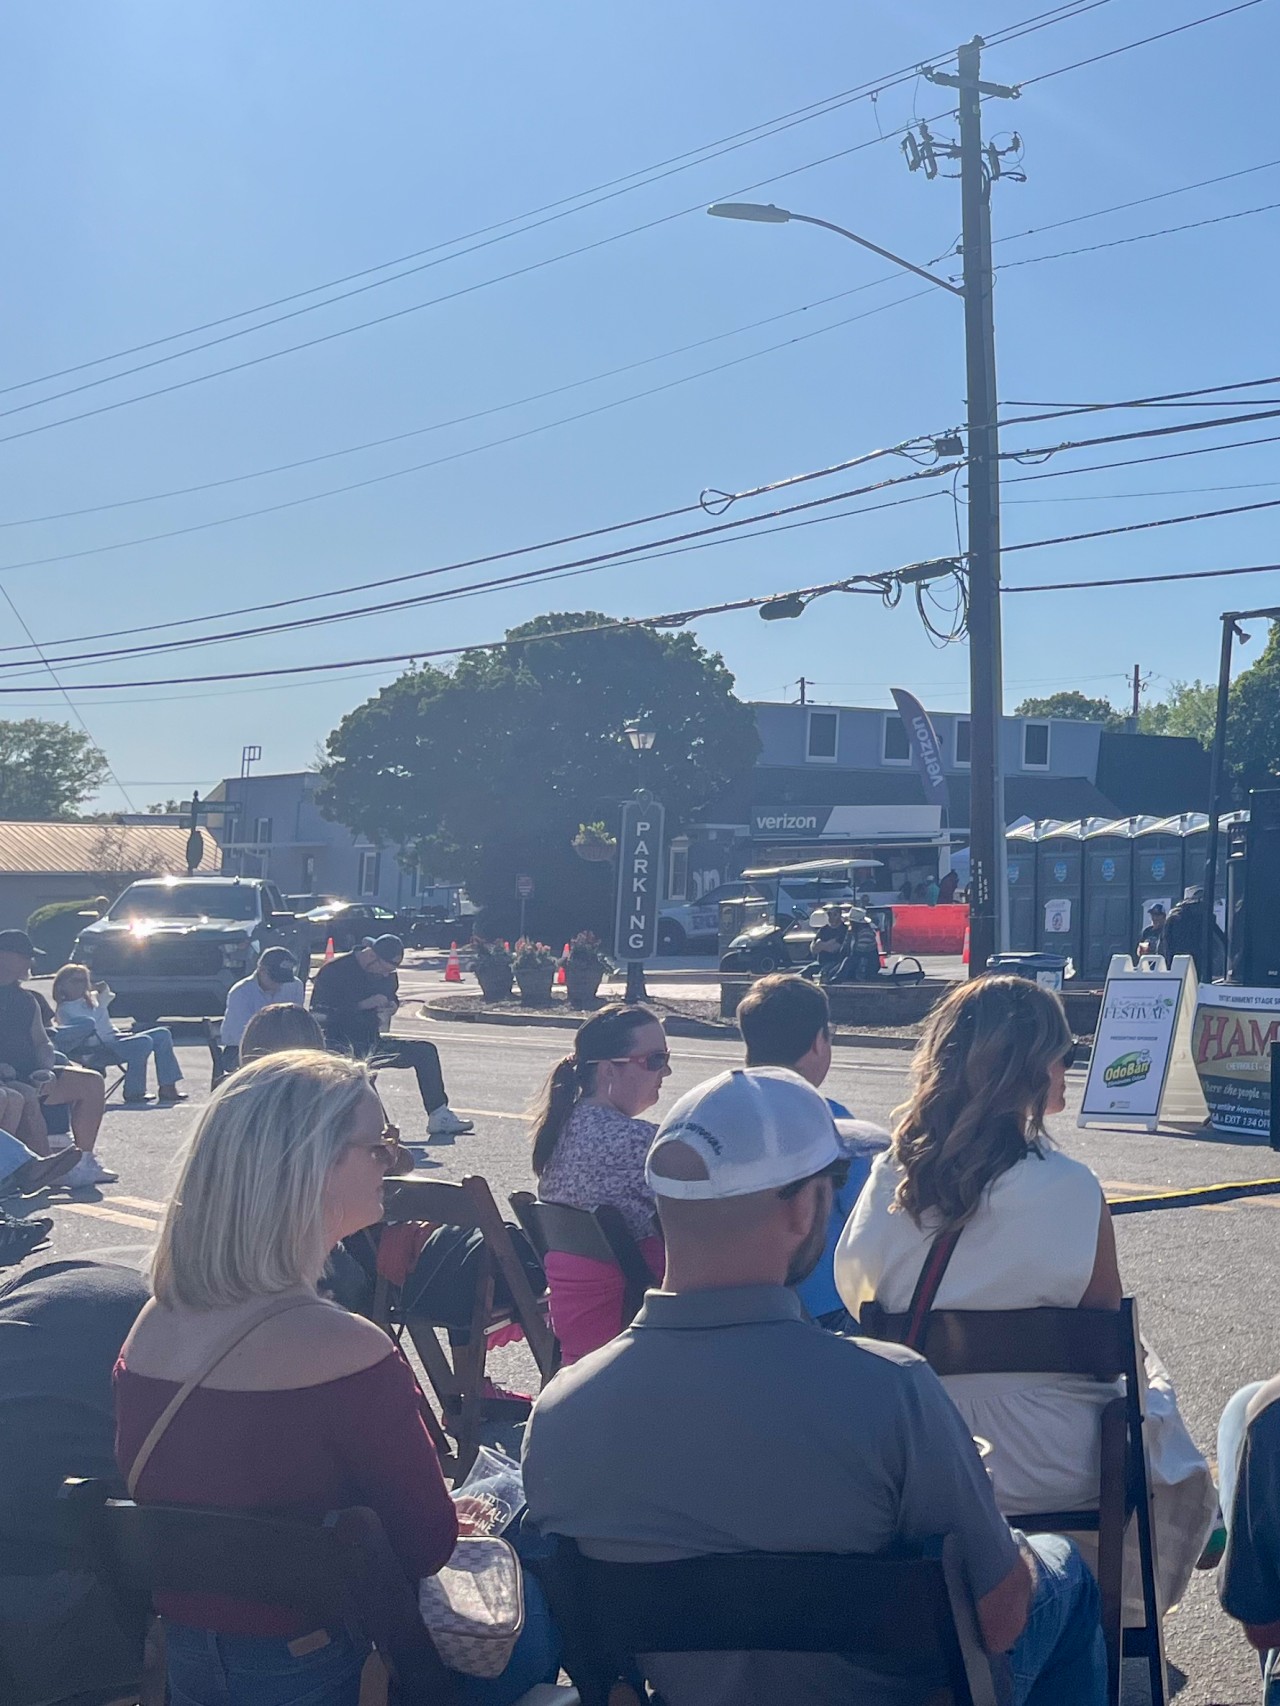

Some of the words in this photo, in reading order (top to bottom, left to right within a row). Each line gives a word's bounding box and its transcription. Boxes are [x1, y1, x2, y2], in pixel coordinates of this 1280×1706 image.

[912, 716, 944, 787] verizon
[756, 813, 817, 829] verizon
[628, 821, 650, 949] PARKING
[1105, 1062, 1149, 1081] OdoBan
[1224, 1114, 1241, 1124] EXIT
[1242, 1117, 1256, 1126] 134
